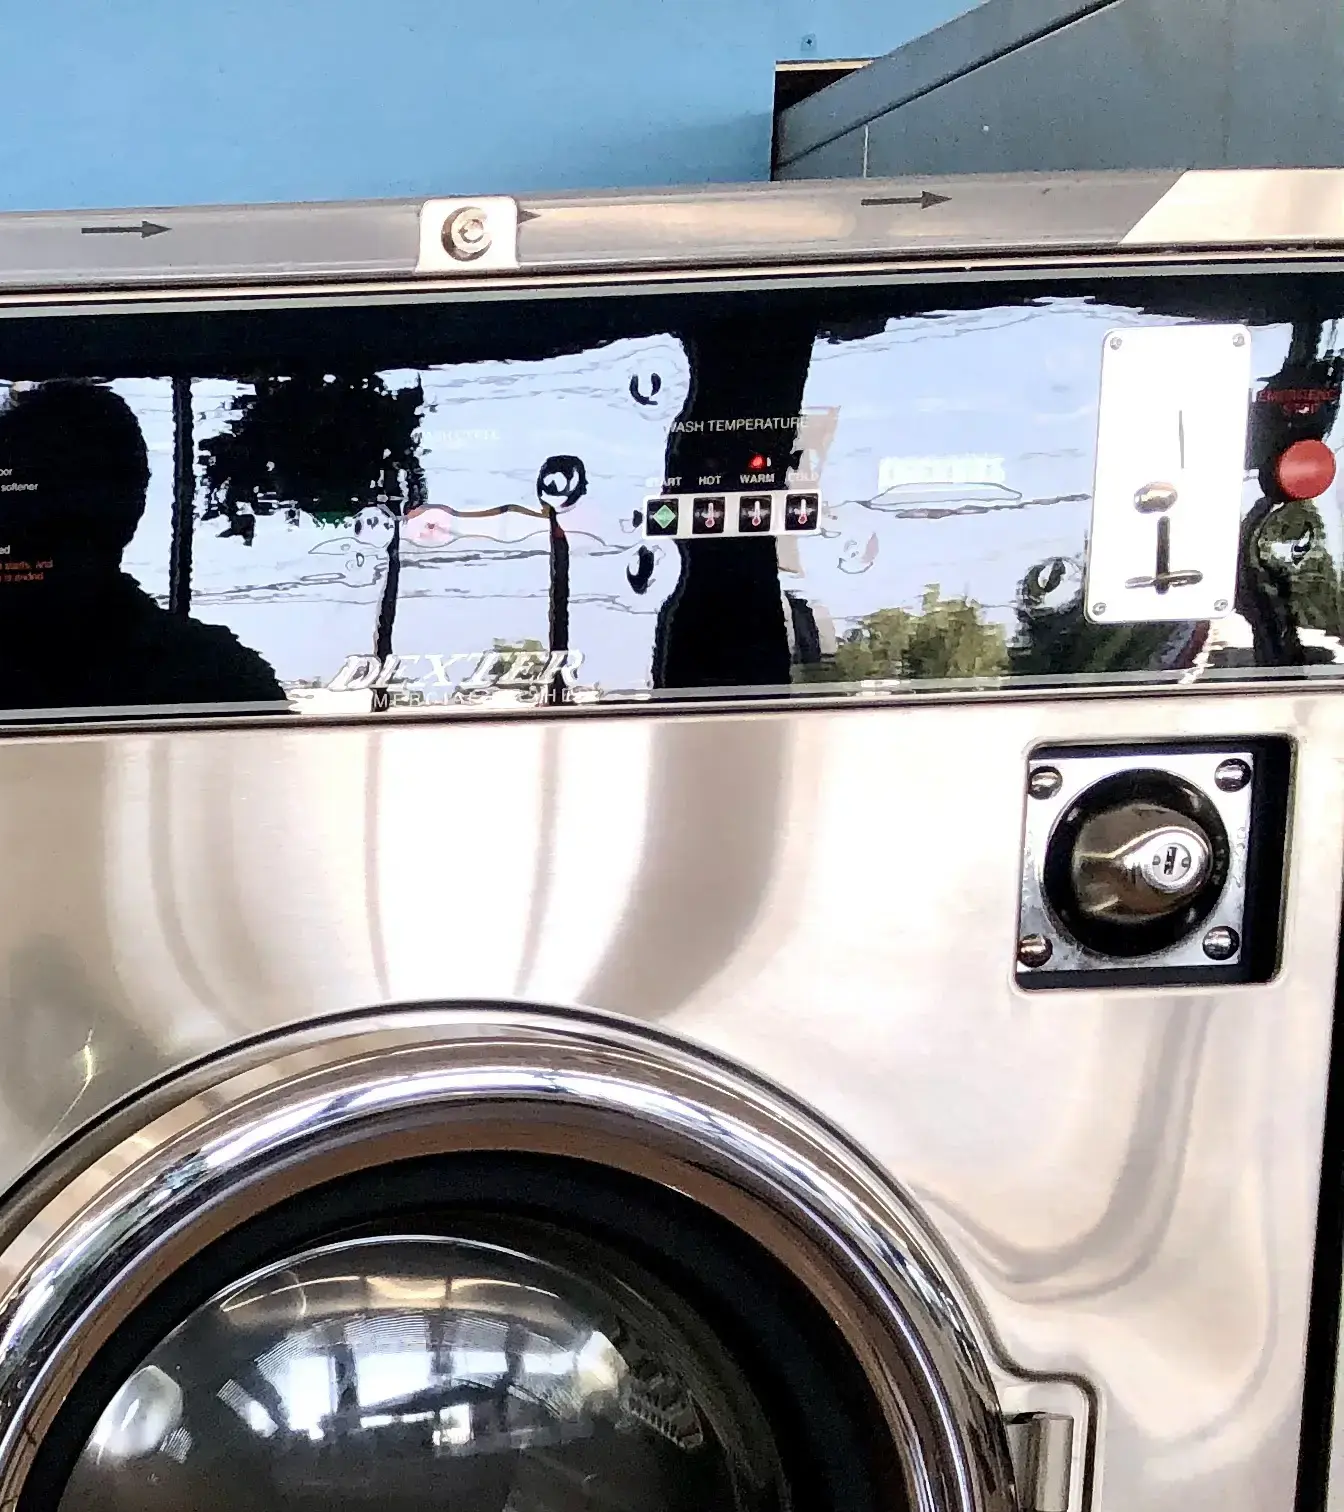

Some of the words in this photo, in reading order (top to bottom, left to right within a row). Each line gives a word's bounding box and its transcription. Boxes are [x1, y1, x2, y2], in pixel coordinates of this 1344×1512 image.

[708, 417, 809, 431] TEMPERATURE
[699, 476, 722, 485] HOT
[740, 473, 775, 483] WARM
